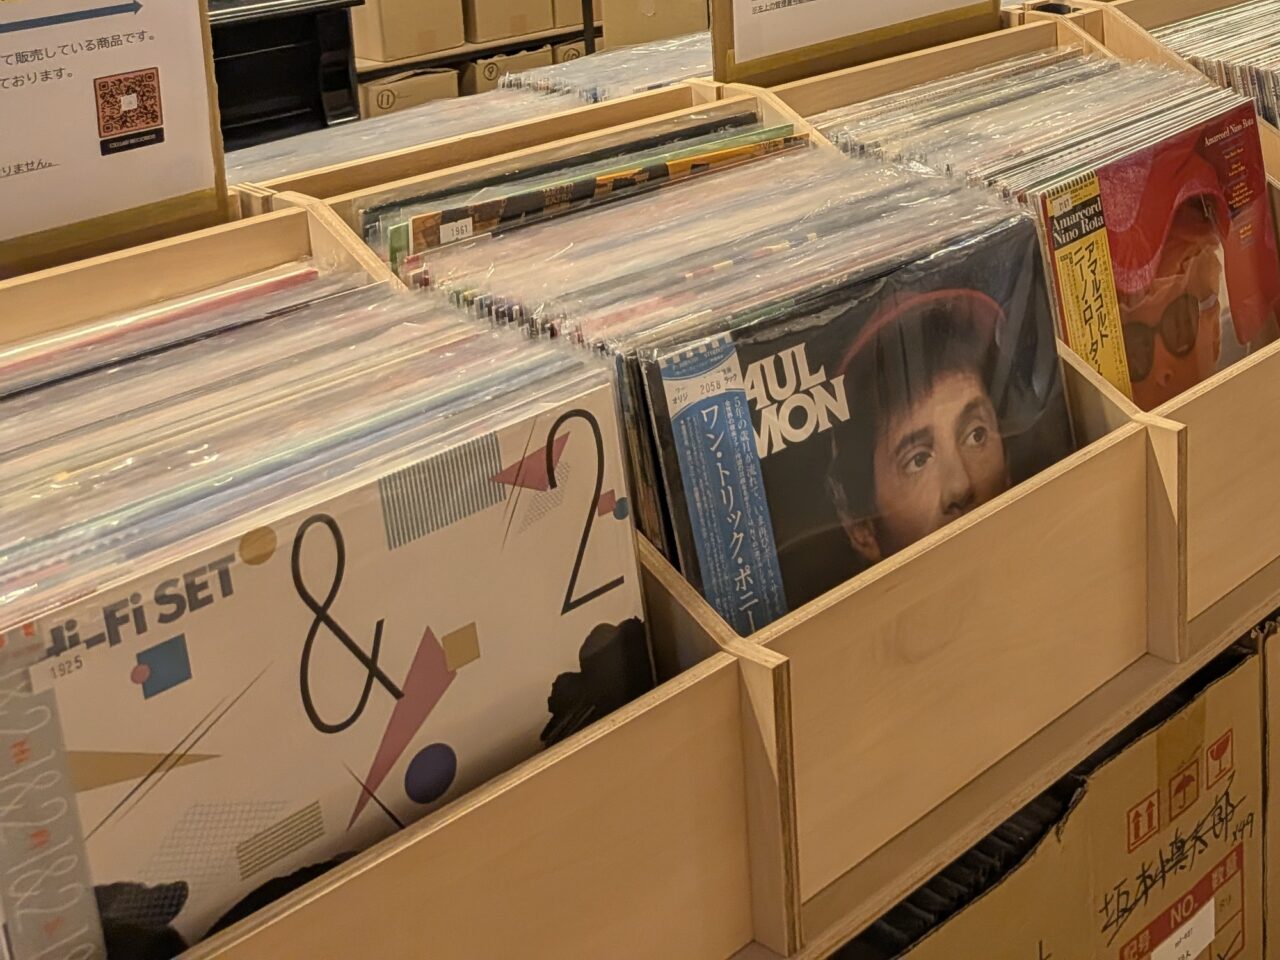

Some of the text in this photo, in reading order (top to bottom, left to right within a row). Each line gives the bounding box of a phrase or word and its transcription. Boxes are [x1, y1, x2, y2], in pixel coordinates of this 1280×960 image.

[1204, 126, 1230, 147] Amarcord
[1053, 196, 1102, 231] Amarcord
[1053, 215, 1105, 248] Nino Rota
[1084, 240, 1110, 348] アマルコルド
[700, 381, 722, 396] 2058
[744, 342, 827, 411] AUL
[752, 374, 851, 460] MON
[154, 554, 237, 625] SET
[49, 654, 84, 680] 1925
[1170, 895, 1199, 929] NO.
